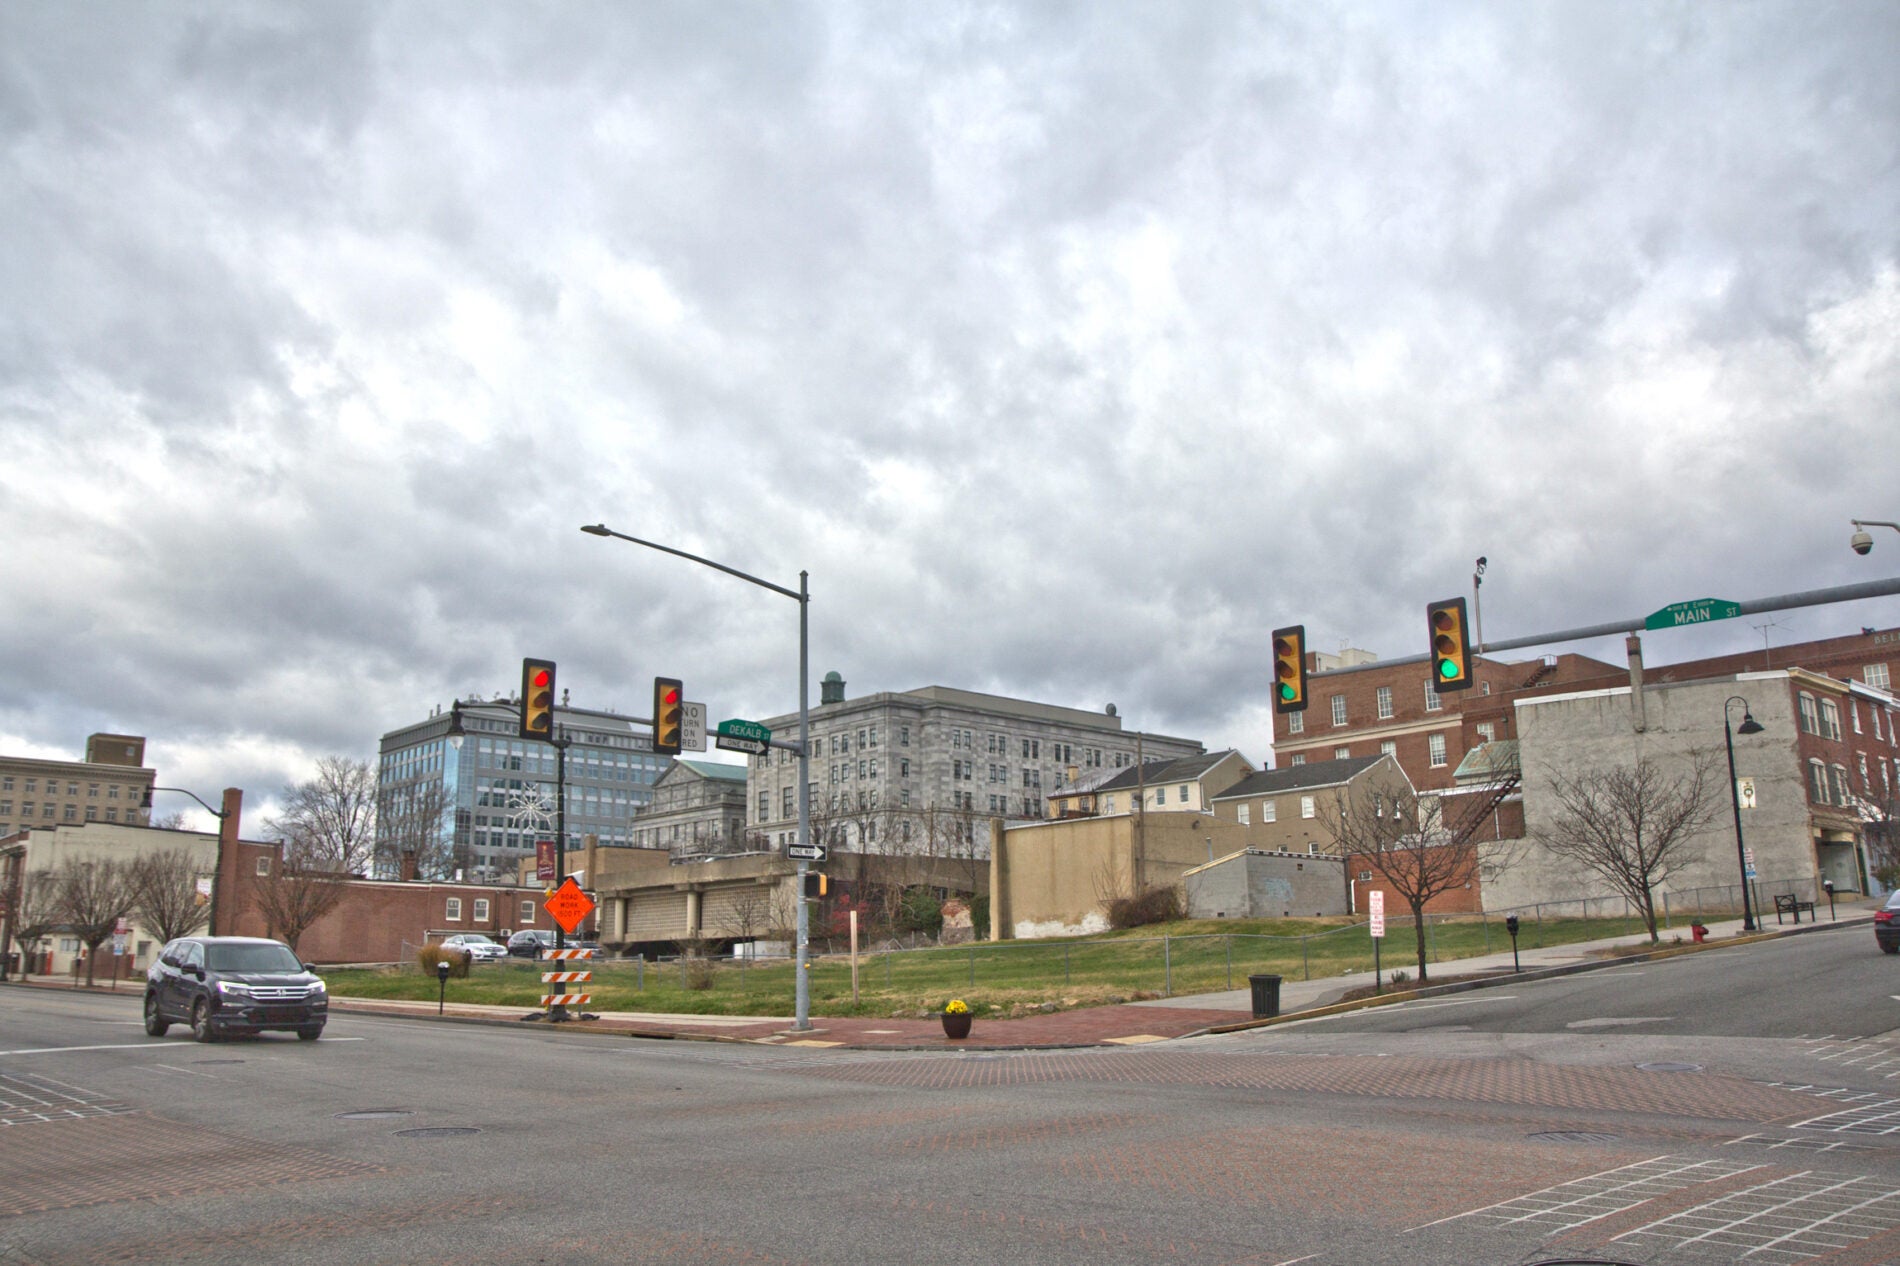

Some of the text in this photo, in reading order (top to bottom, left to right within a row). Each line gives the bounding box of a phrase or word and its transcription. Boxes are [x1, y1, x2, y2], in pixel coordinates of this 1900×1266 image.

[1674, 607, 1737, 625] MAIN ST
[1874, 631, 1900, 645] BEL
[682, 707, 698, 718] NO
[683, 729, 696, 738] ON
[729, 724, 762, 740] DEKALB
[682, 738, 698, 748] RED
[727, 739, 758, 751] ONE WAY
